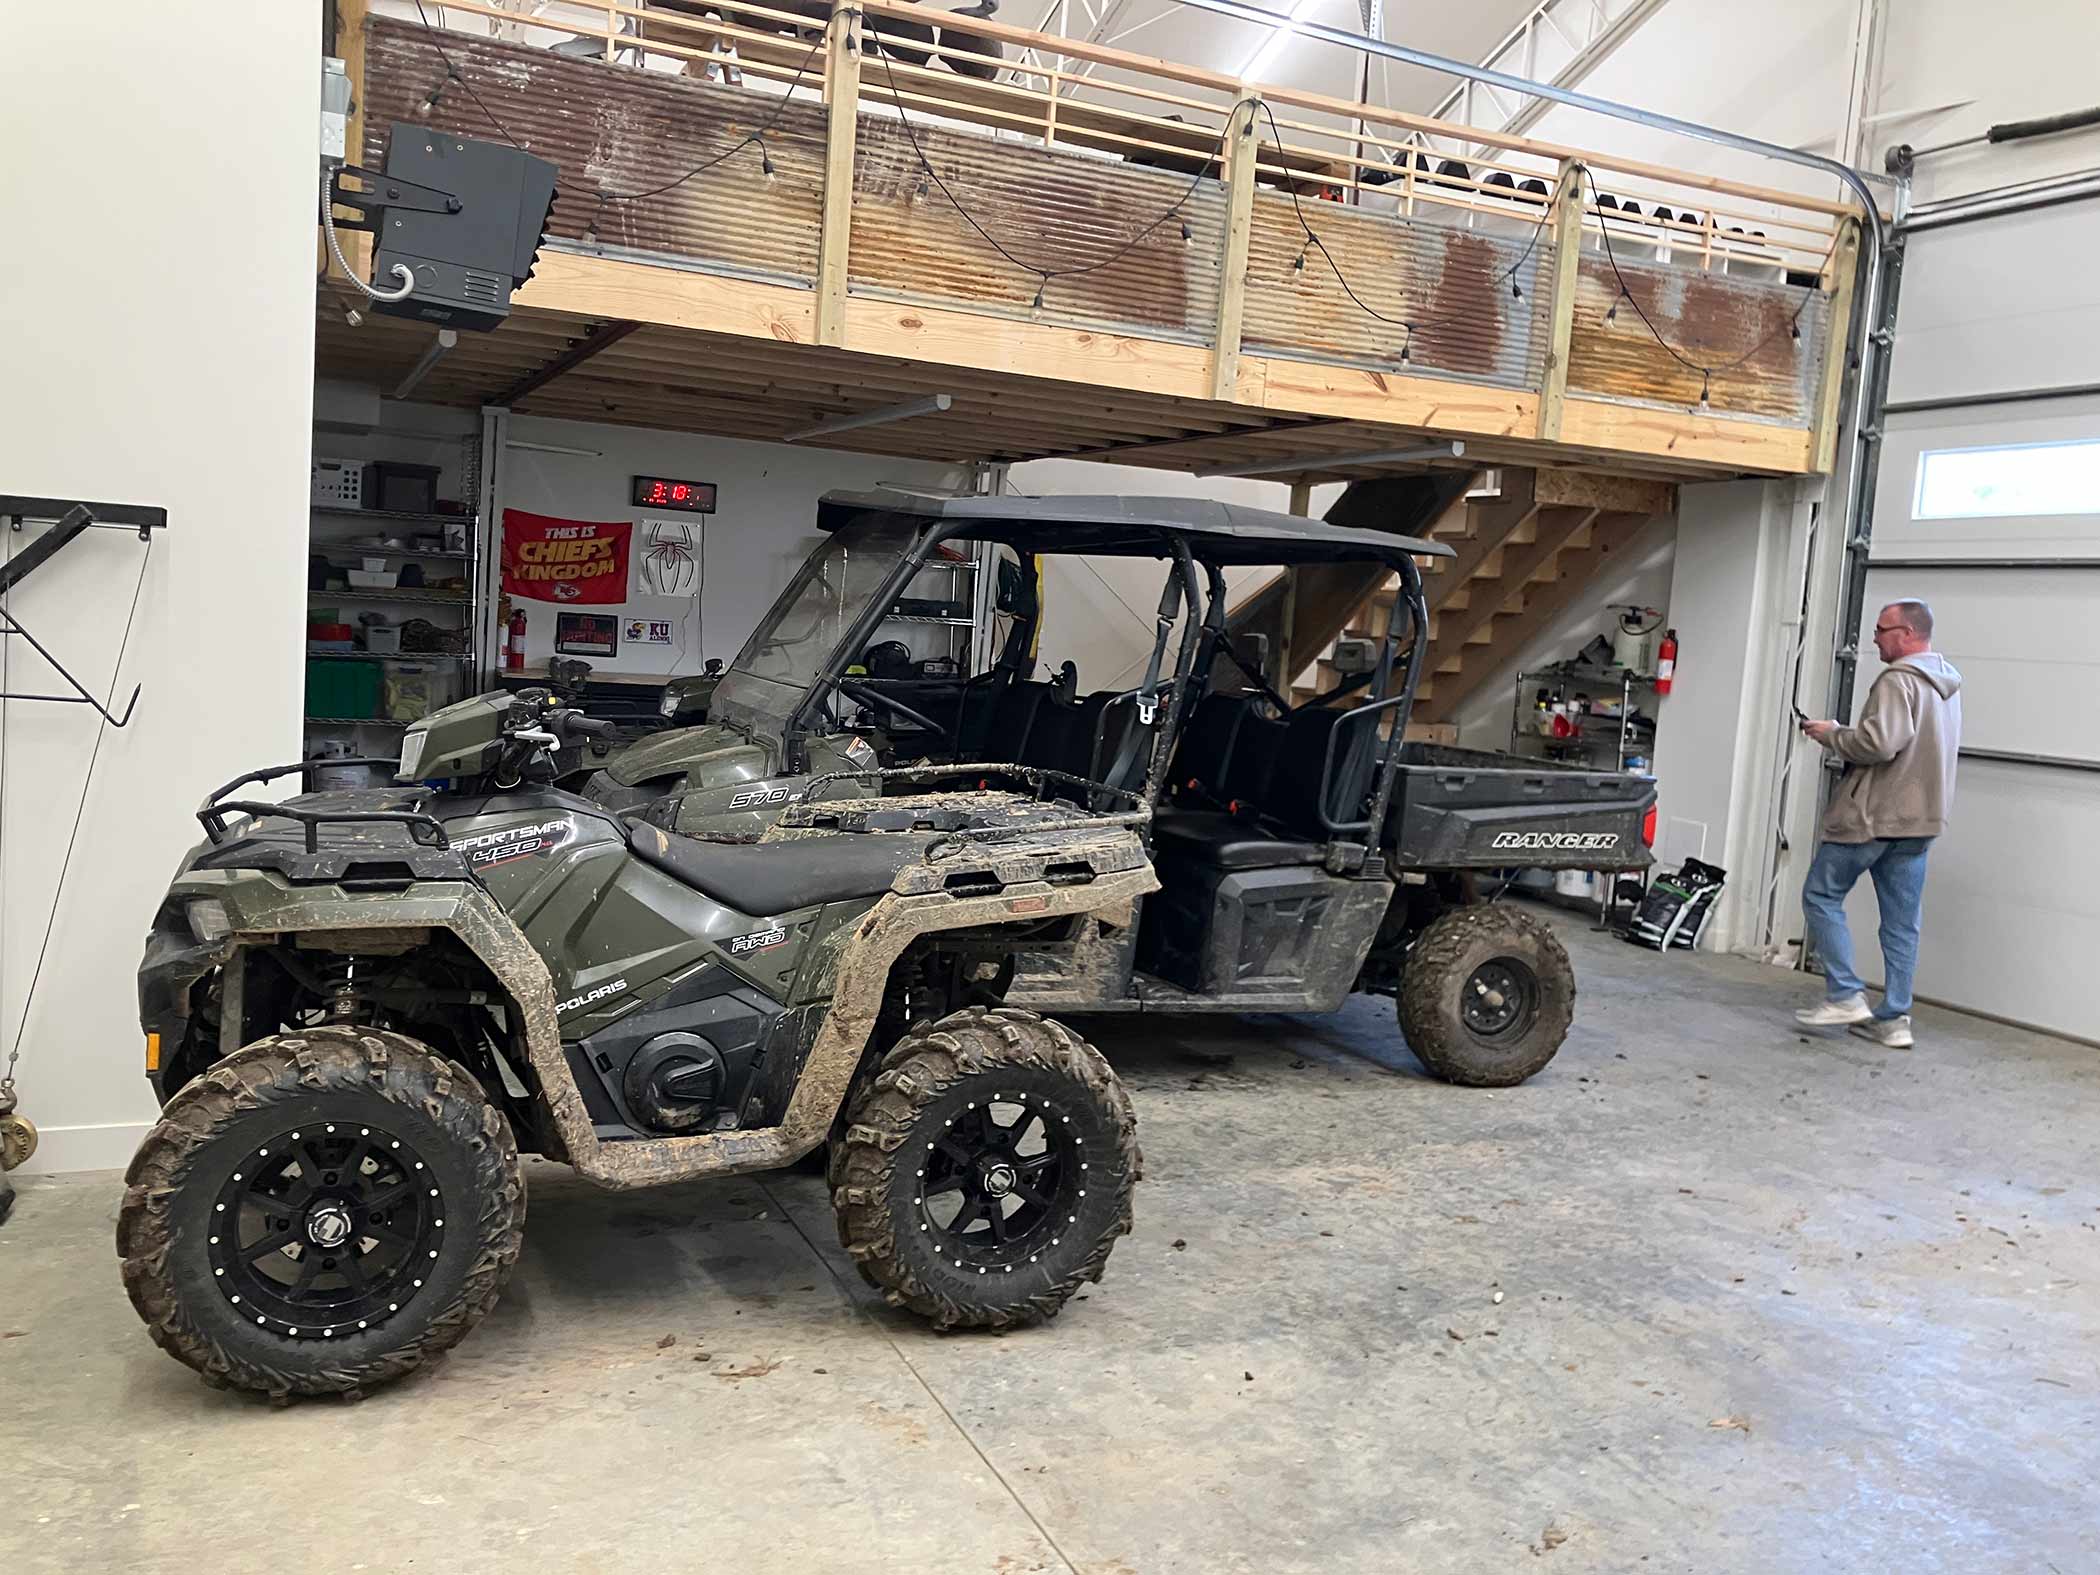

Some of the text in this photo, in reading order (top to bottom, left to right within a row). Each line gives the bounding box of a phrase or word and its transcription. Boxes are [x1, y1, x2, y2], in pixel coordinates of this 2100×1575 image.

[545, 525, 596, 539] THIS IS
[518, 536, 615, 562] CHIEFS
[512, 560, 615, 580] KINGDOM
[649, 622, 669, 636] KU
[729, 787, 790, 809] 570
[449, 815, 574, 852] SPORTSMAN
[1491, 832, 1619, 849] RANGER
[472, 837, 542, 864] 450
[731, 932, 785, 954] AWD
[554, 979, 628, 1016] POLARIS
